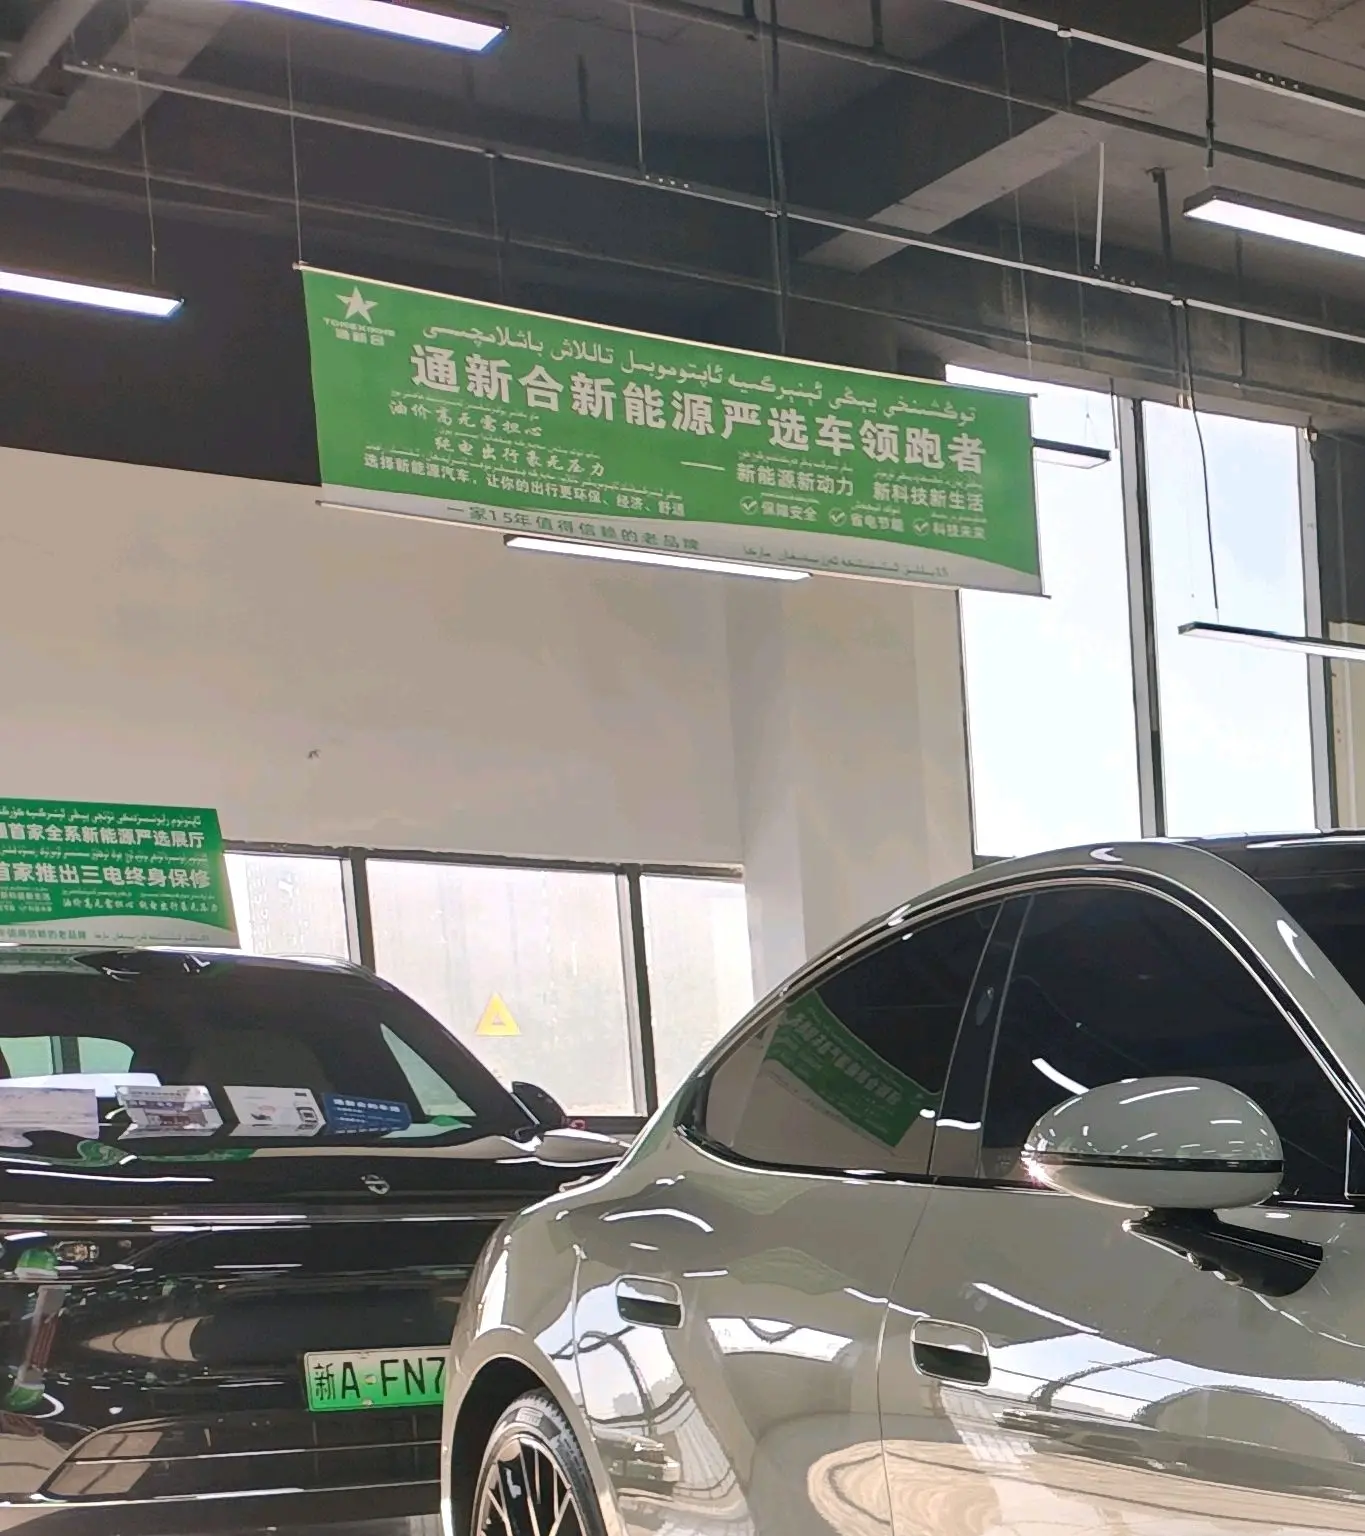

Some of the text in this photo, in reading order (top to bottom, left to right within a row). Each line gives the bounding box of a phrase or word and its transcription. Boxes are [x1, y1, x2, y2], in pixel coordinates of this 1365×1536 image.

[410, 344, 987, 475] 通新合新能源严选车领跑者
[313, 1356, 446, 1401] 新A FN7
